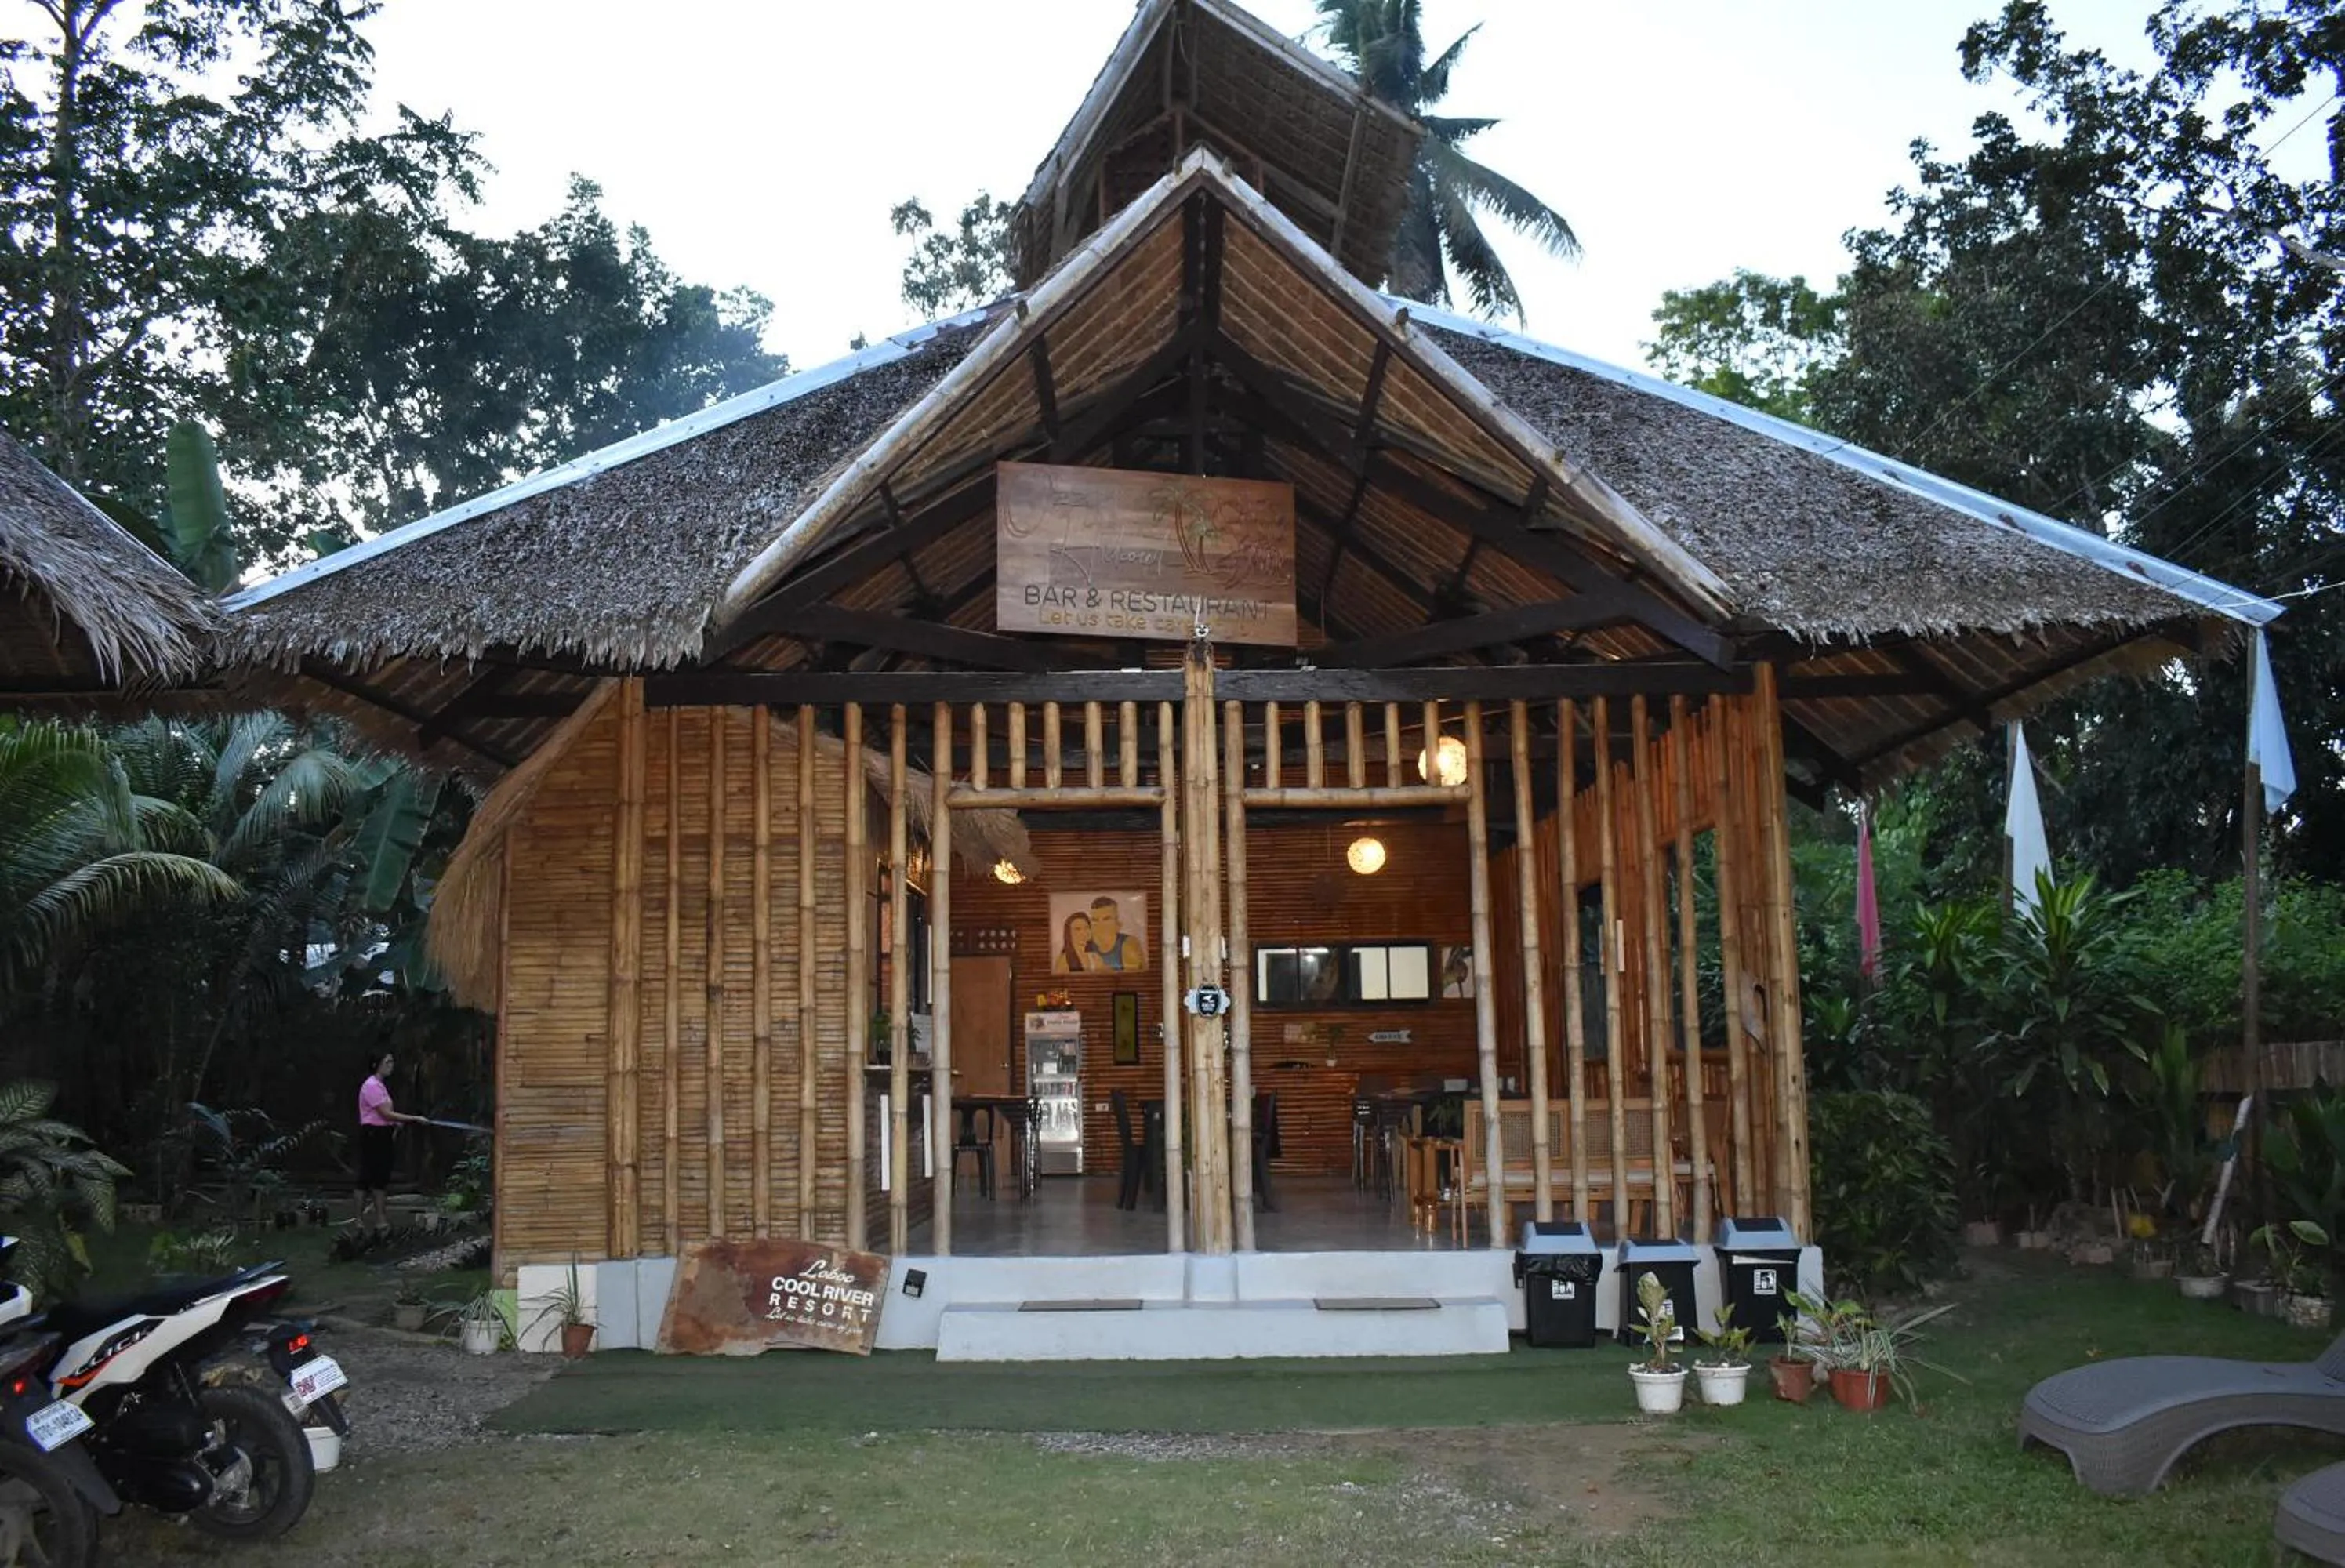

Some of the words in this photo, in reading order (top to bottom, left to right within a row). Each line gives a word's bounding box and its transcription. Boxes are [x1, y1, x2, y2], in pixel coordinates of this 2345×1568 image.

[1025, 583, 1077, 609] BAR
[1086, 586, 1102, 608] &
[1110, 590, 1272, 621] RESTAURANT
[799, 1259, 855, 1283] Loboc
[771, 1276, 821, 1298] COOL
[822, 1284, 875, 1307] RIVER
[768, 1293, 873, 1323] RESORT
